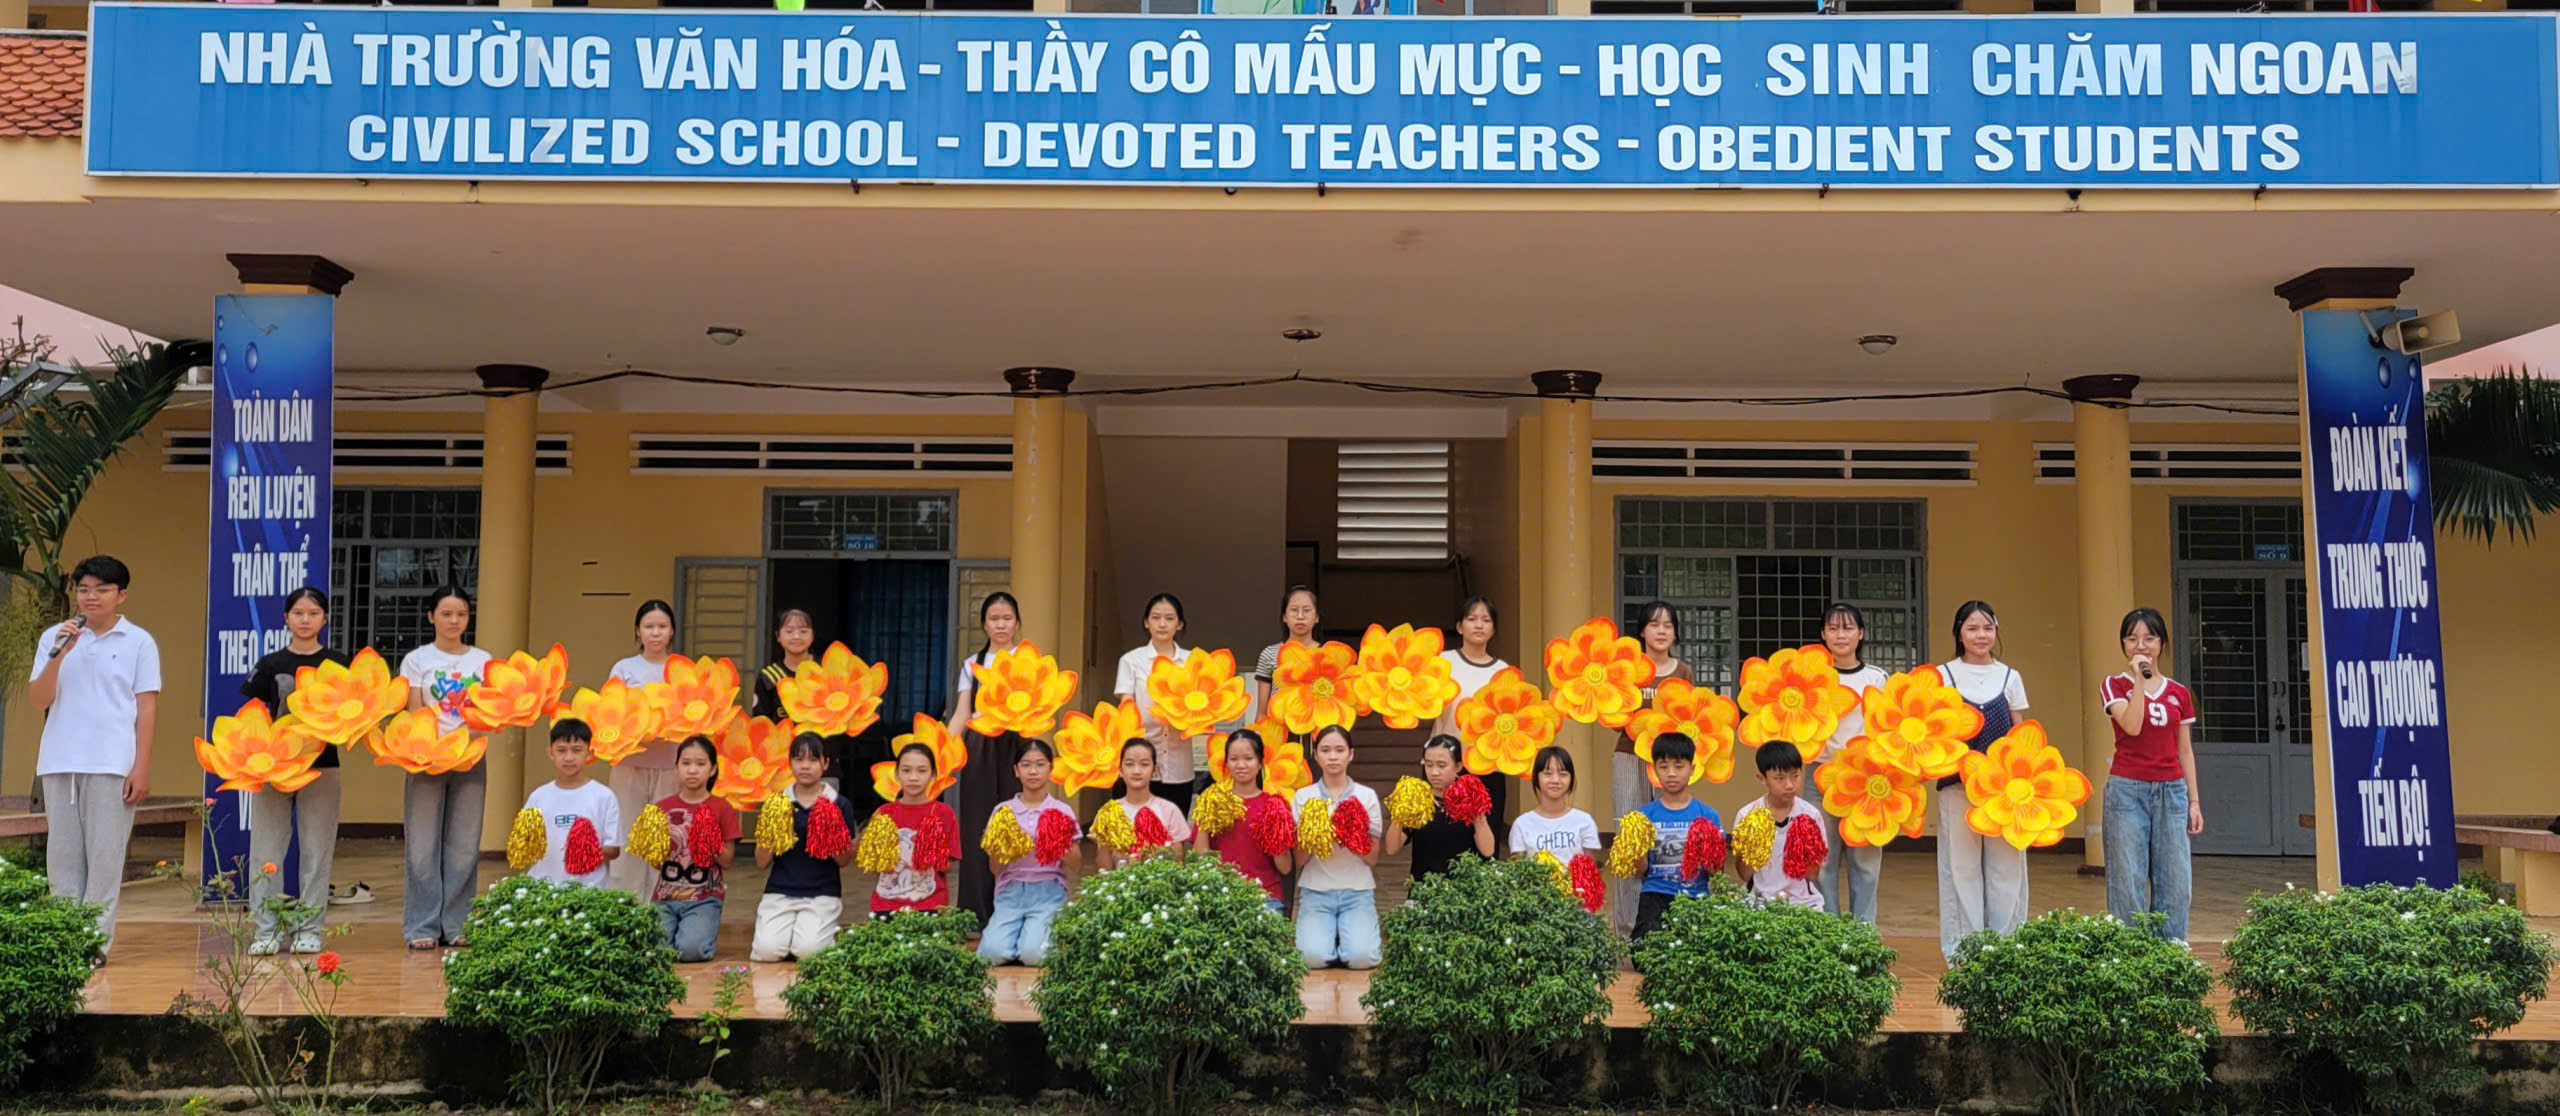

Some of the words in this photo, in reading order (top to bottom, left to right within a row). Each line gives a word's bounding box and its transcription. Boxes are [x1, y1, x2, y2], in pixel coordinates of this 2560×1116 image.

[200, 22, 332, 85] NHÀ
[353, 20, 610, 89] TRƯỜNG
[636, 27, 757, 90] VĂN
[782, 25, 906, 91] HÓA
[957, 19, 1109, 93] THẦY
[1129, 29, 1210, 94] CÔ
[1234, 22, 1376, 95] MẪU
[1399, 37, 1542, 106] MỰC
[1598, 43, 1722, 107] HỌC
[1766, 43, 1929, 96] SINH
[1972, 32, 2163, 96] CHĂM
[2190, 41, 2417, 95] NGOAN
[348, 114, 649, 165] CIVILIZED
[676, 118, 918, 166] SCHOOL
[983, 121, 1256, 169] DEVOTED
[1282, 123, 1600, 171] TEACHERS
[1658, 124, 1951, 172] OBEDIENT
[1975, 123, 2300, 172] STUDENTS
[233, 389, 275, 442] TOÀN
[279, 389, 313, 442] DÂN
[2329, 411, 2378, 492] ĐOÀN
[2378, 403, 2409, 491] KẾT
[228, 465, 260, 519] RÈN
[264, 465, 315, 529] LUYỆN
[232, 543, 275, 597] THÂN
[278, 533, 309, 597] THỂ
[2327, 542, 2384, 609] TRUNG
[2384, 535, 2428, 623] THỰC
[218, 629, 258, 675] THEO
[2148, 702, 2168, 727] 9
[2336, 660, 2370, 728] CAO
[2370, 652, 2439, 742] THƯỢNG
[1536, 831, 1576, 851] CHEER
[2358, 757, 2399, 847] TIẾN
[2399, 764, 2431, 862] BỘ!
